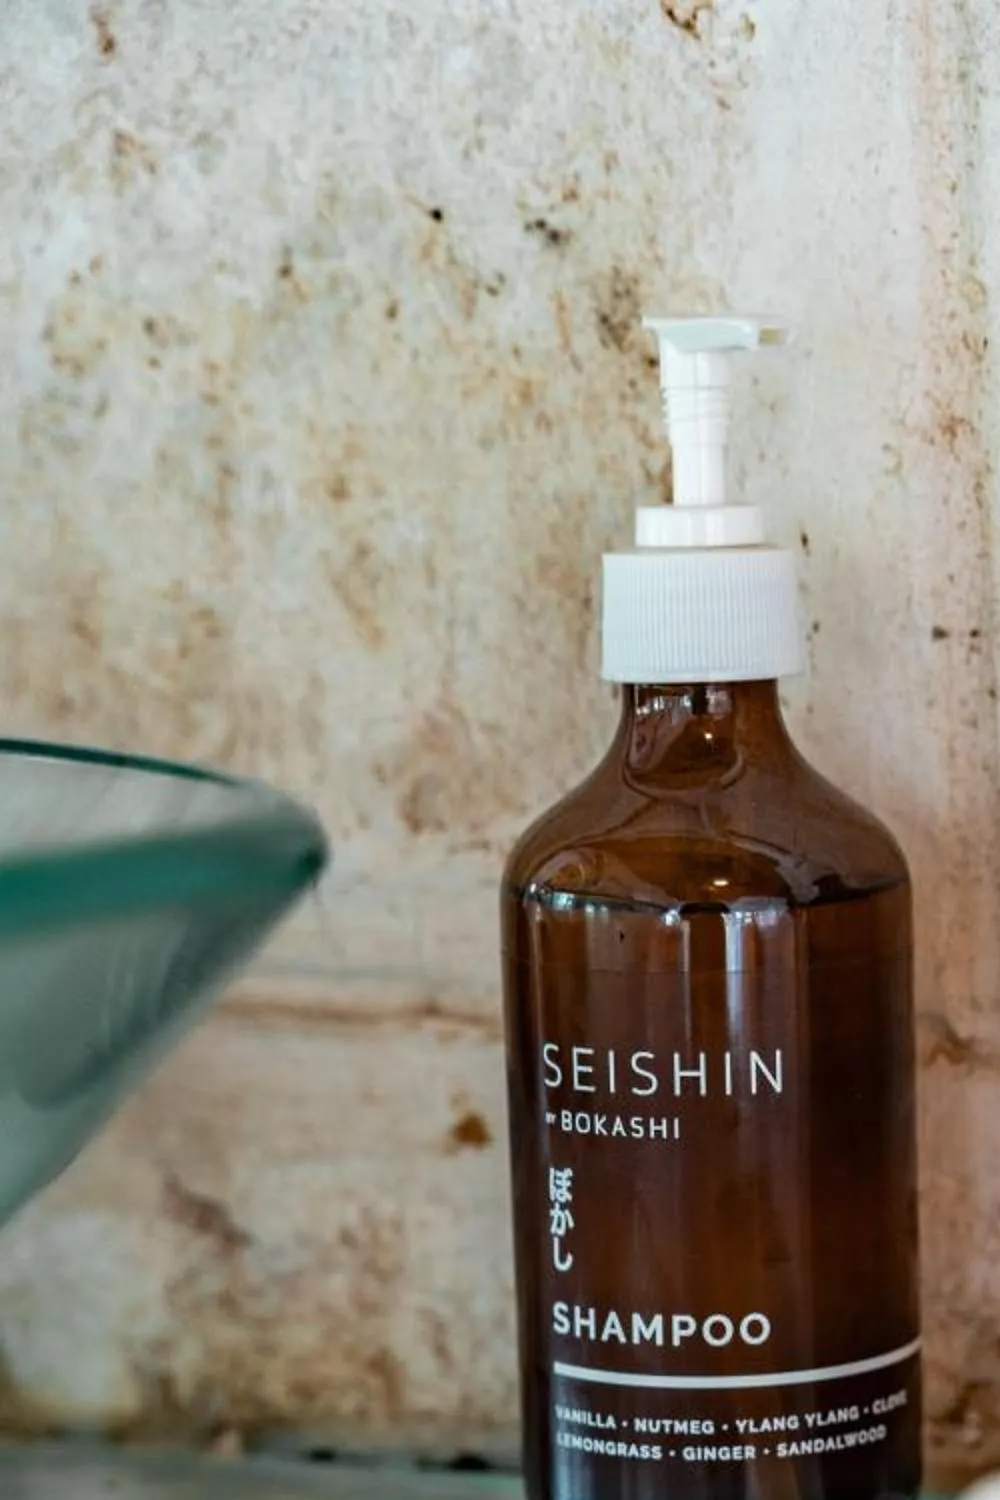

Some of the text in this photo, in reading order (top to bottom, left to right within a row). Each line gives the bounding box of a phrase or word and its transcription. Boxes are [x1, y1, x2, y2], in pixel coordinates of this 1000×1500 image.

[543, 1042, 783, 1097] SEISHIN
[561, 1109, 680, 1139] BOKASHI
[552, 1301, 771, 1347] SHAMPOO
[556, 1405, 616, 1430] VANILLA
[635, 1418, 714, 1435] NUTMEG
[736, 1415, 799, 1434] YLANG
[805, 1406, 859, 1428] YLANG
[557, 1425, 887, 1461] LEMONGRASS GINGER SANDALWOOD
